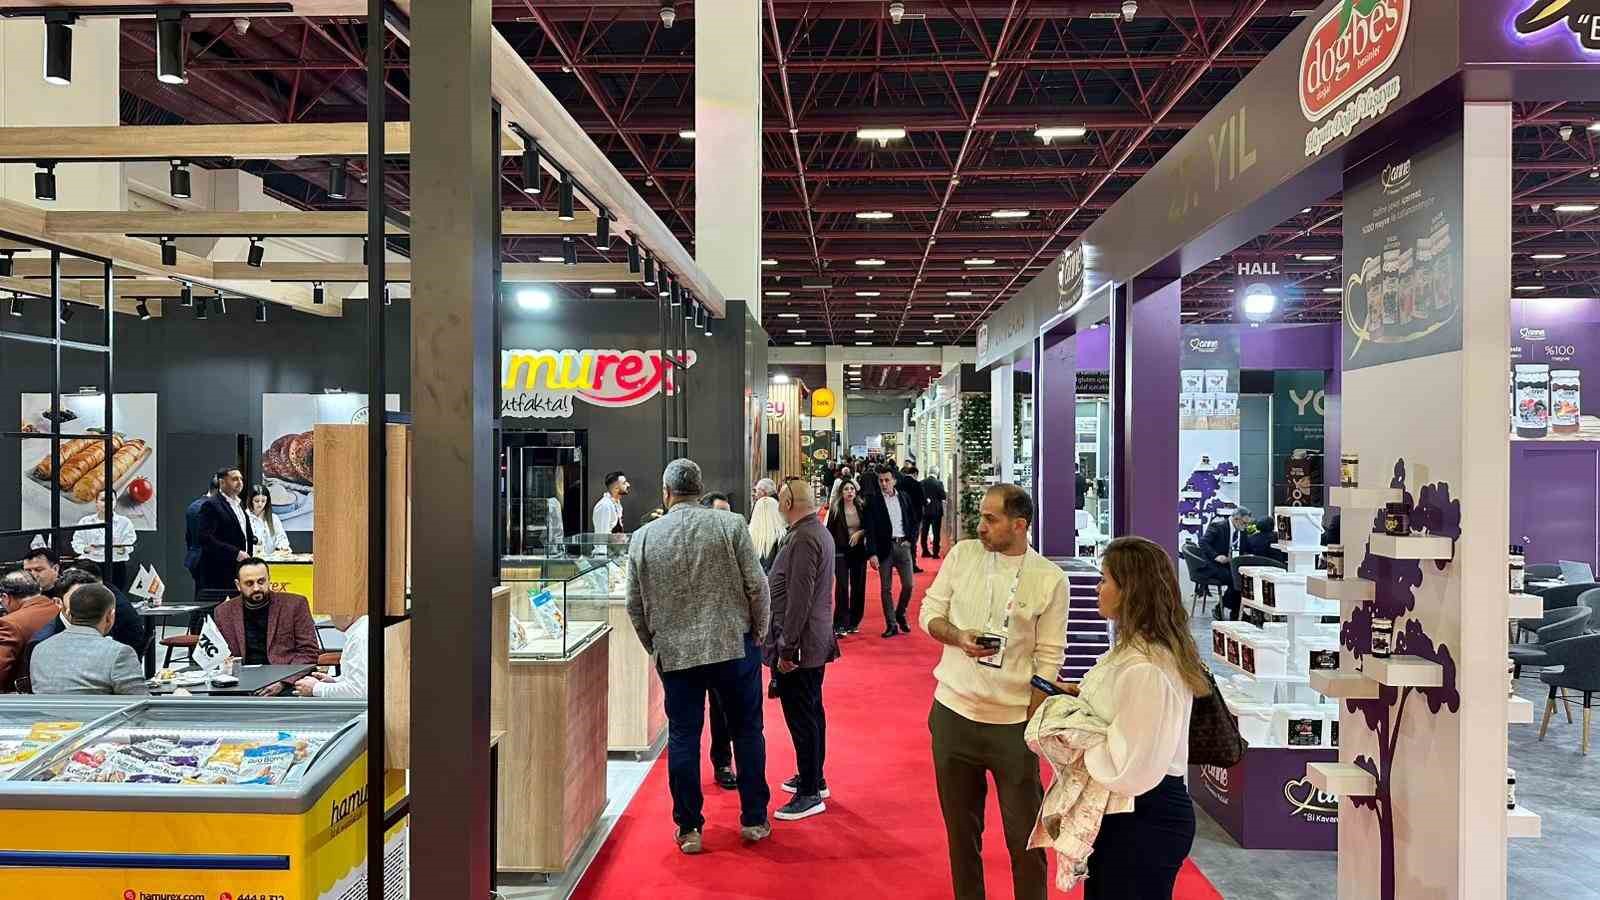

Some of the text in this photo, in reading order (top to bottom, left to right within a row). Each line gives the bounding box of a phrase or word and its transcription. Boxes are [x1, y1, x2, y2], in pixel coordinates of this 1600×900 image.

[1208, 107, 1257, 192] YIL
[1237, 262, 1280, 276] HALL
[1544, 345, 1575, 356] %100
